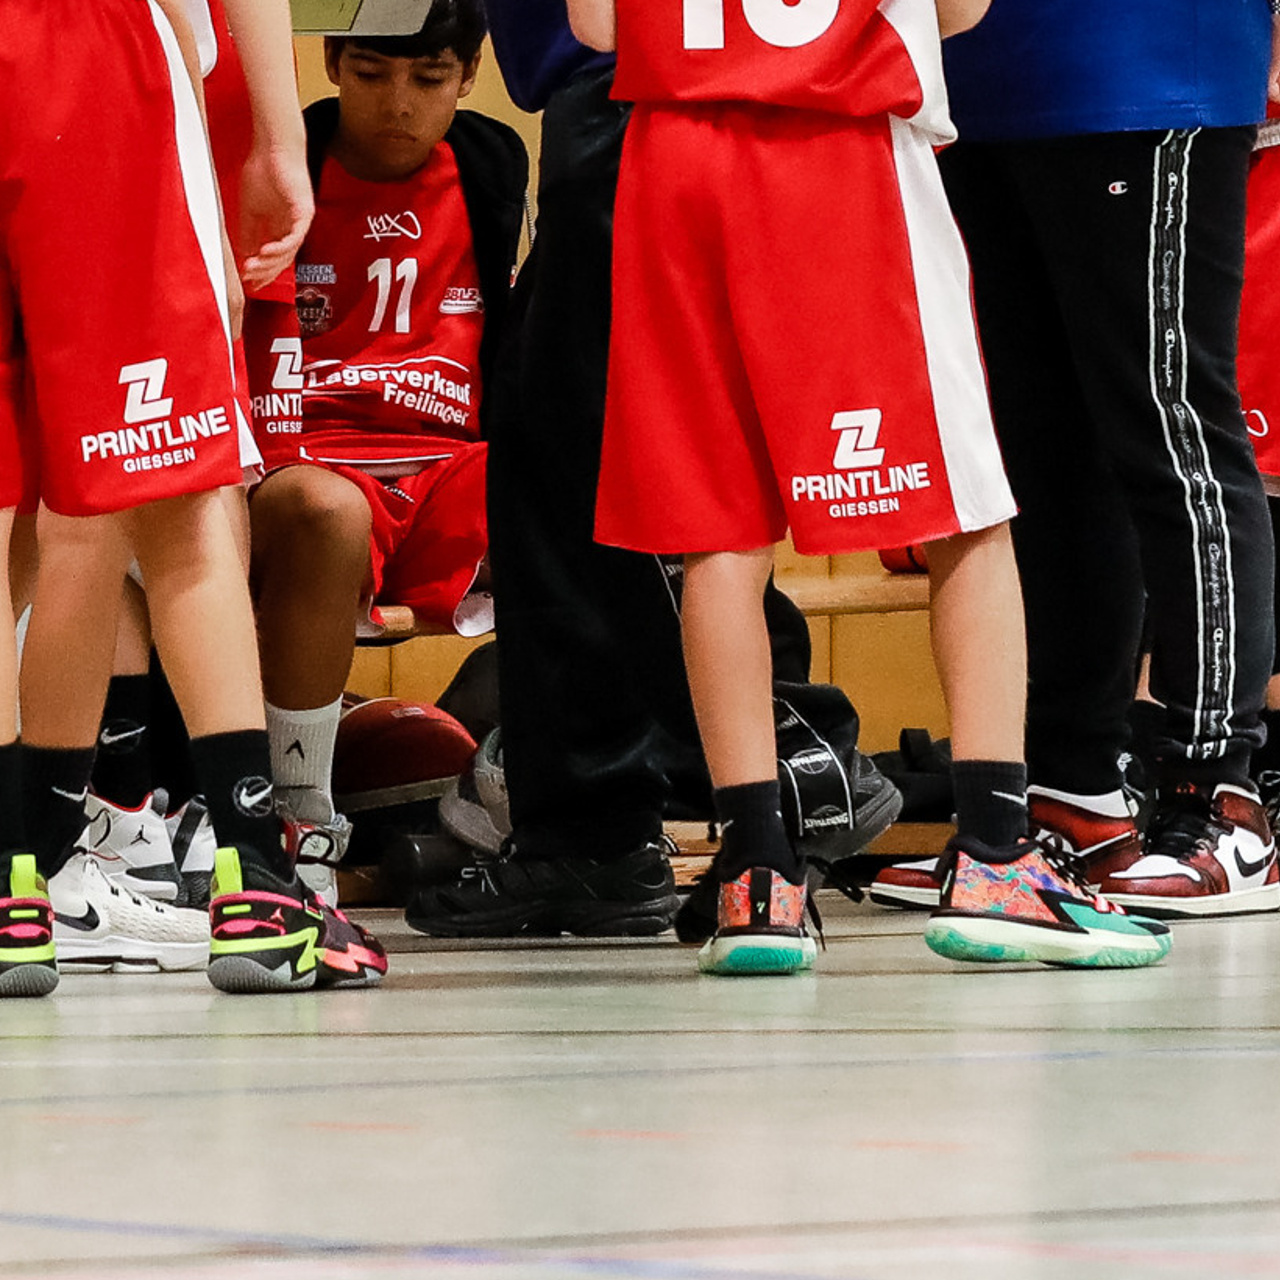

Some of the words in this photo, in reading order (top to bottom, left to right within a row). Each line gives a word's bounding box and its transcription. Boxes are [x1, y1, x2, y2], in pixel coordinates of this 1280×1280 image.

[367, 257, 419, 334] 11
[308, 369, 471, 406] Lagerverkauf
[81, 406, 231, 463] PRINTLINE
[122, 446, 196, 474] GIESSEN
[791, 461, 931, 502] PRINTLINE
[828, 497, 900, 518] GIESSEN
